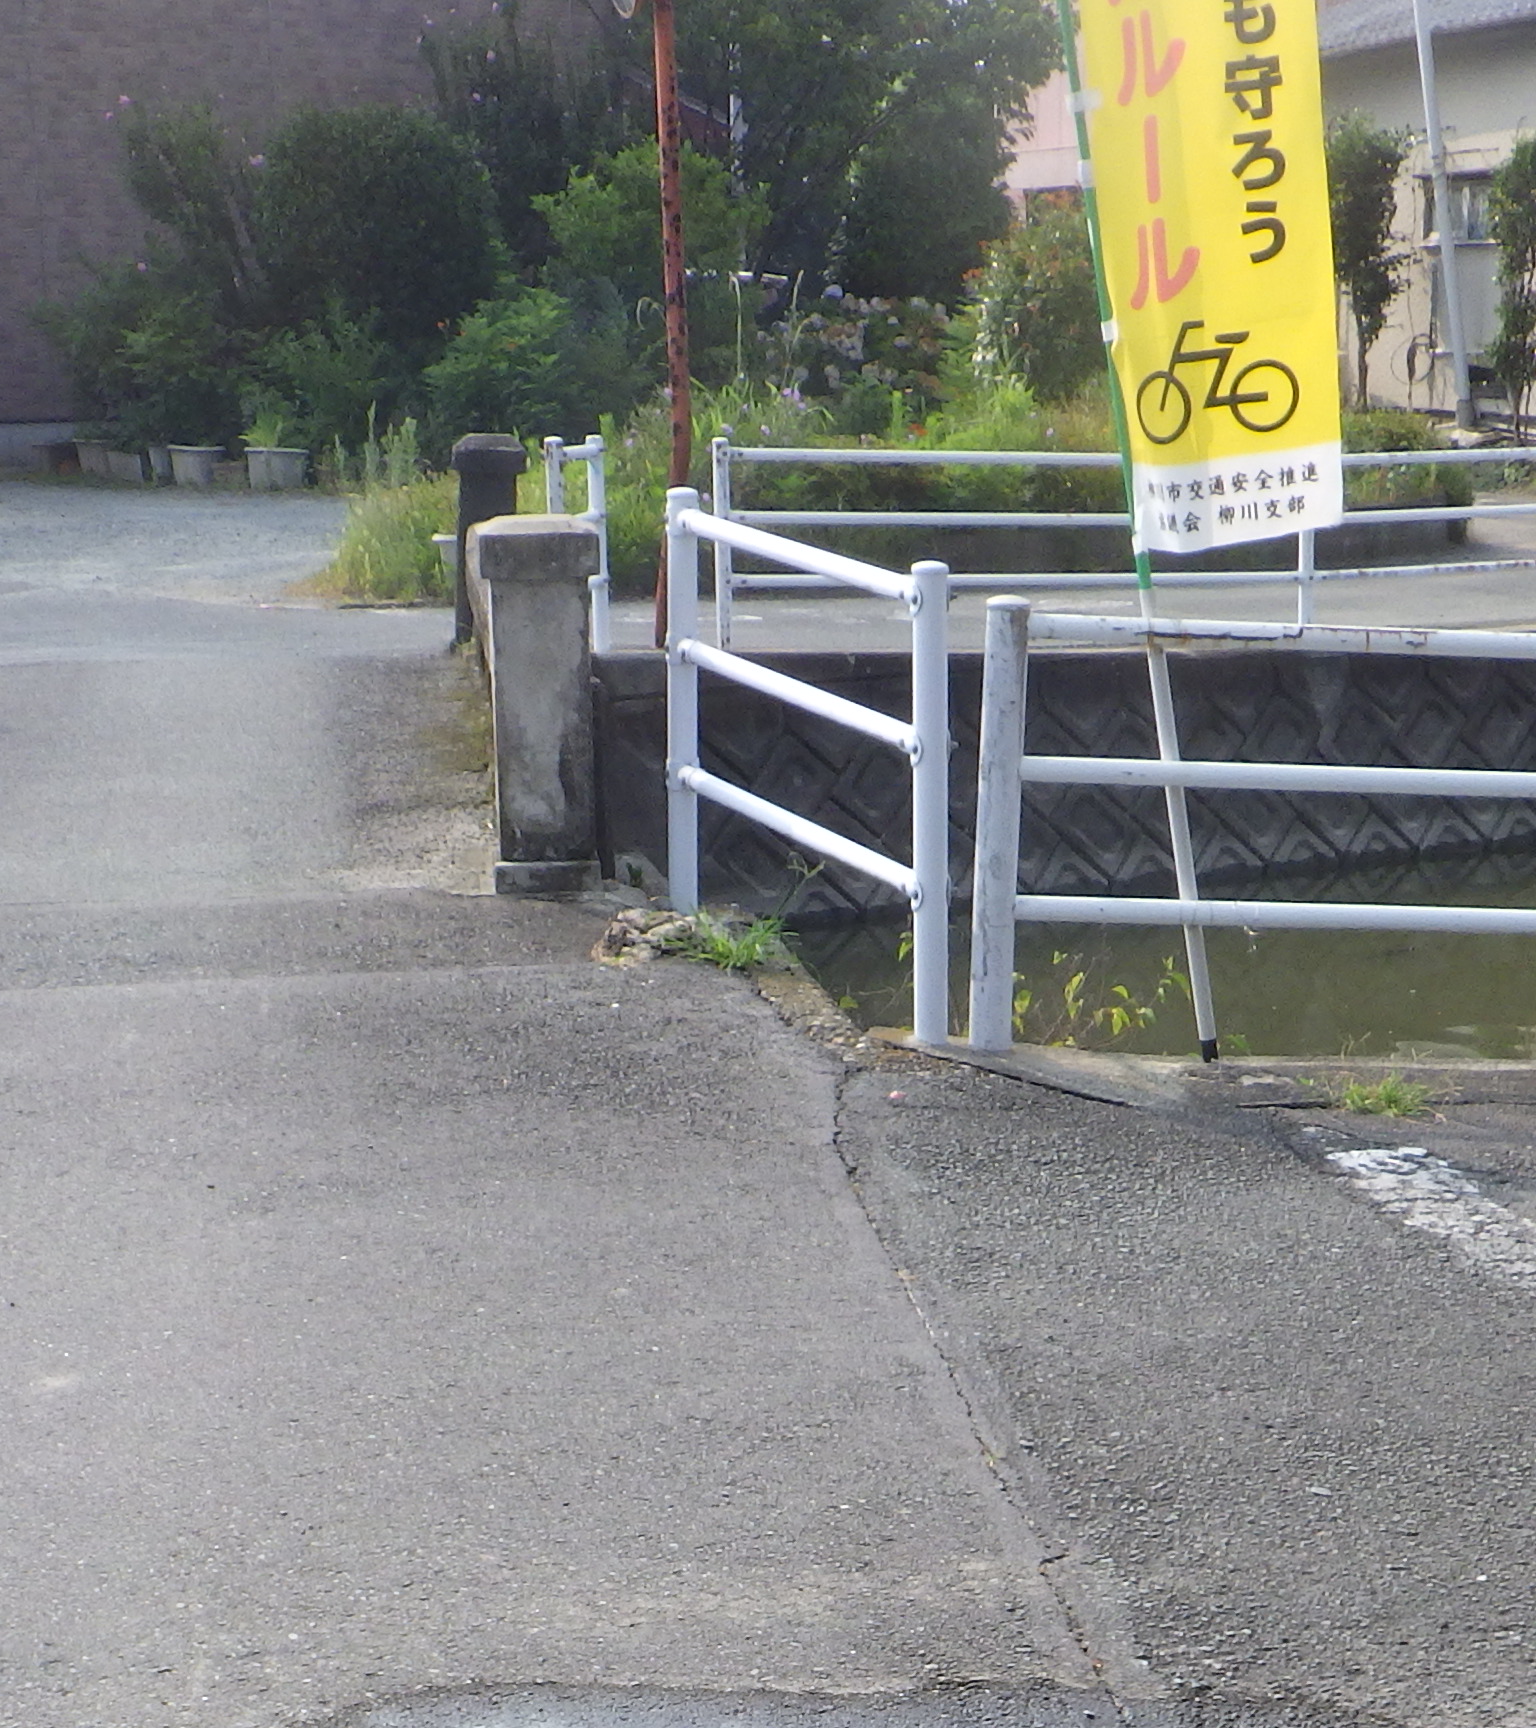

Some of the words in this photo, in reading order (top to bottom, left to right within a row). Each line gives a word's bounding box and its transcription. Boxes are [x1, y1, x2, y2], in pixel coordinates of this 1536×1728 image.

[1108, 0, 1200, 311] ルール
[1223, 0, 1287, 264] も守ろう
